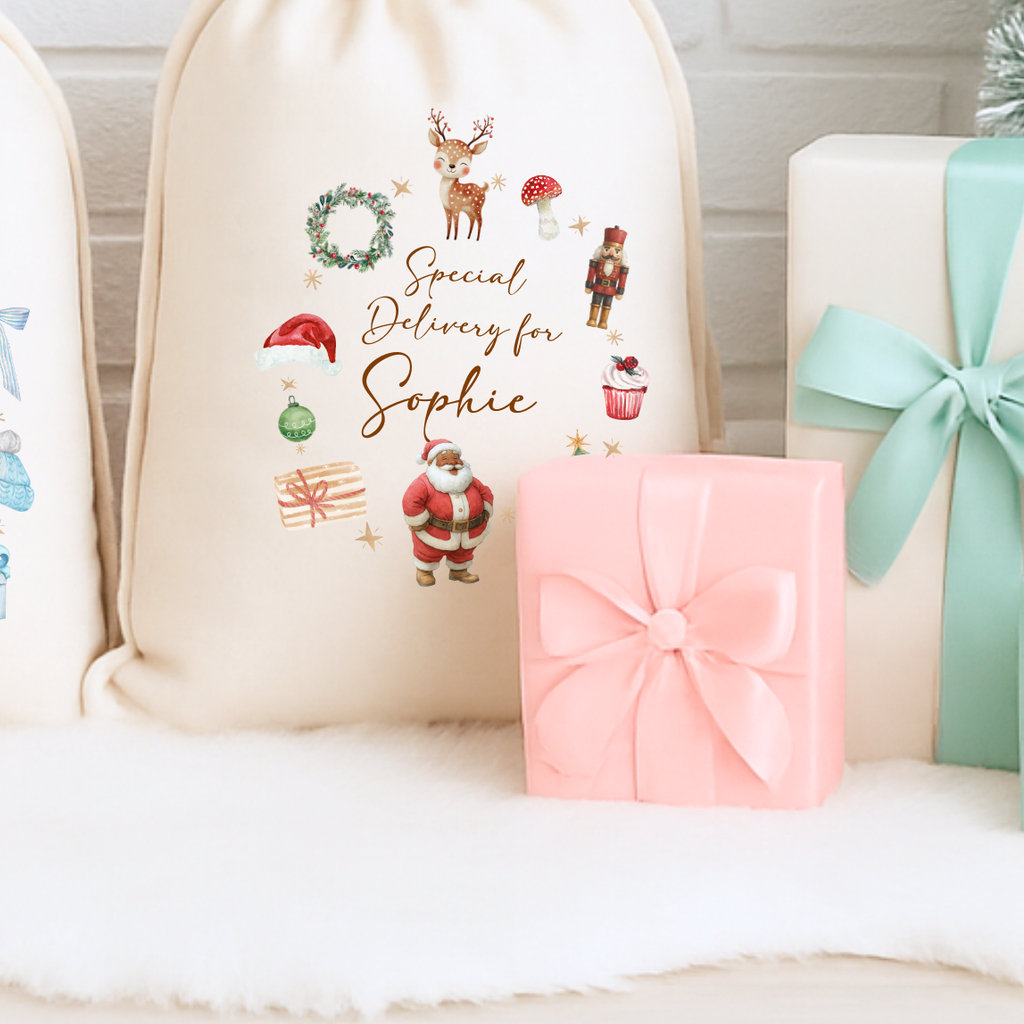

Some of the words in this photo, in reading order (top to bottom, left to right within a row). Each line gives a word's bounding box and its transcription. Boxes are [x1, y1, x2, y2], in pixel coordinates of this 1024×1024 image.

[404, 246, 527, 299] Special
[361, 295, 510, 357] Delivery
[514, 313, 562, 357] for
[361, 352, 537, 442] Sophie
